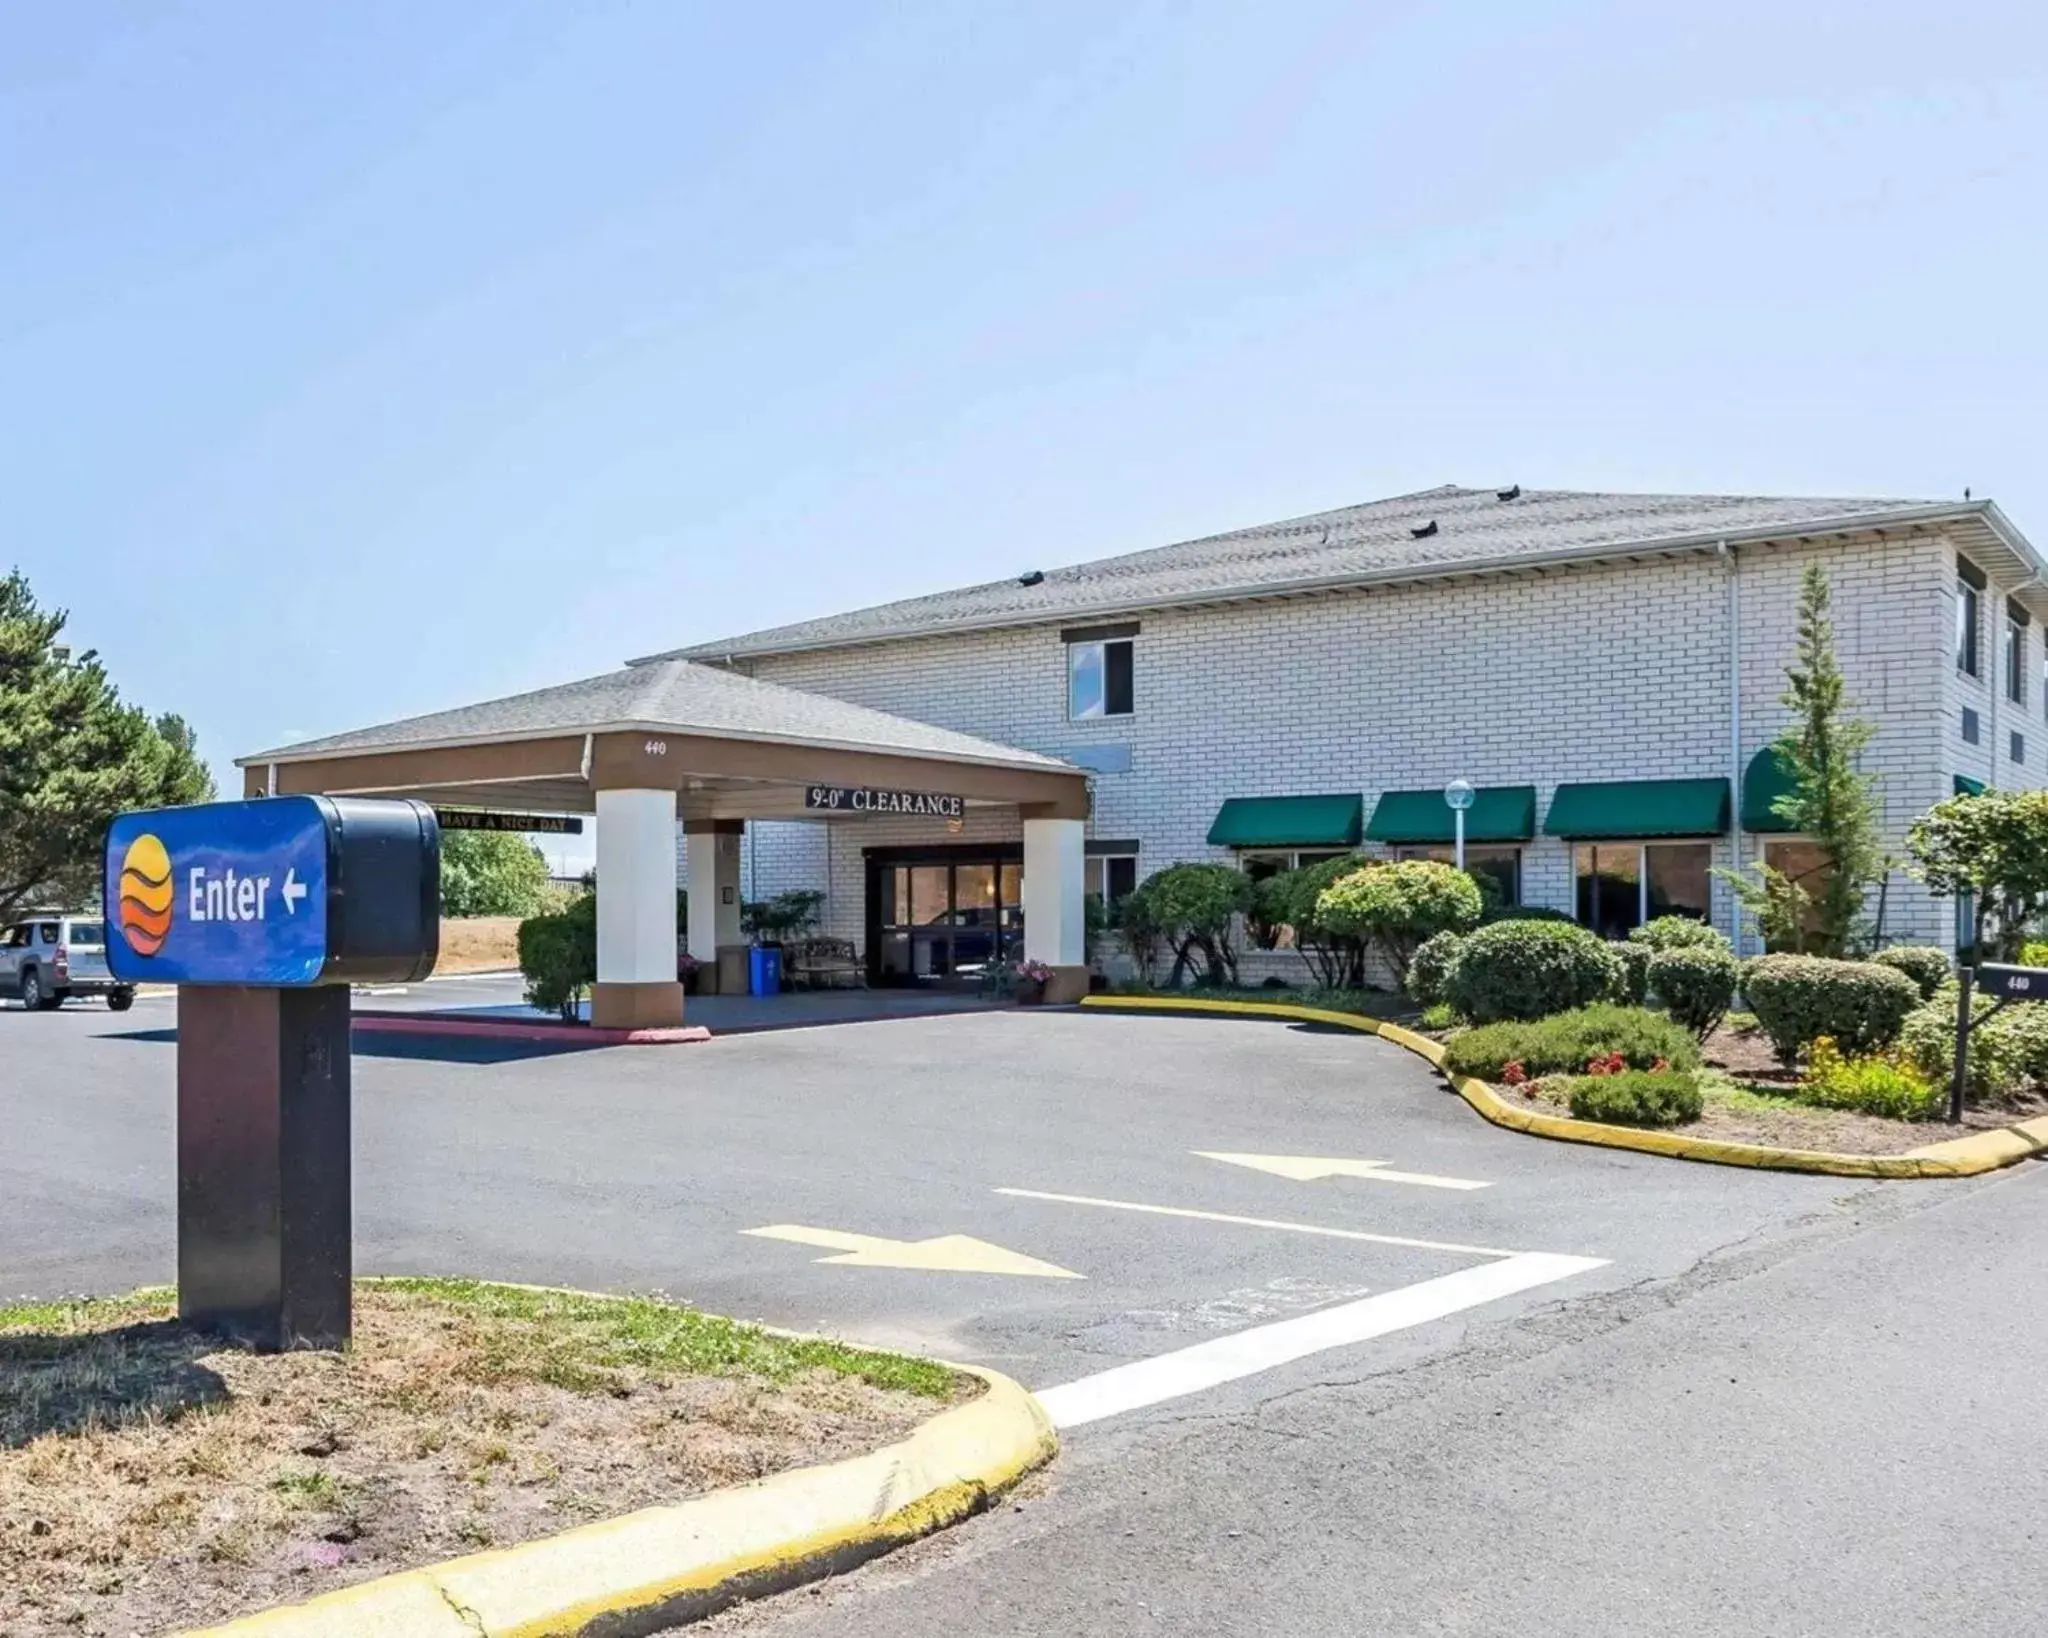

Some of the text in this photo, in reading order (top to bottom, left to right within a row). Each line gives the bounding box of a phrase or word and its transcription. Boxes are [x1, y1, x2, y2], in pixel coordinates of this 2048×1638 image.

[644, 740, 666, 755] 440
[852, 790, 961, 816] CLEARANCE
[440, 813, 567, 832] HAVE A NICE DAY
[189, 867, 270, 921] Enter
[2007, 976, 2030, 990] 440
